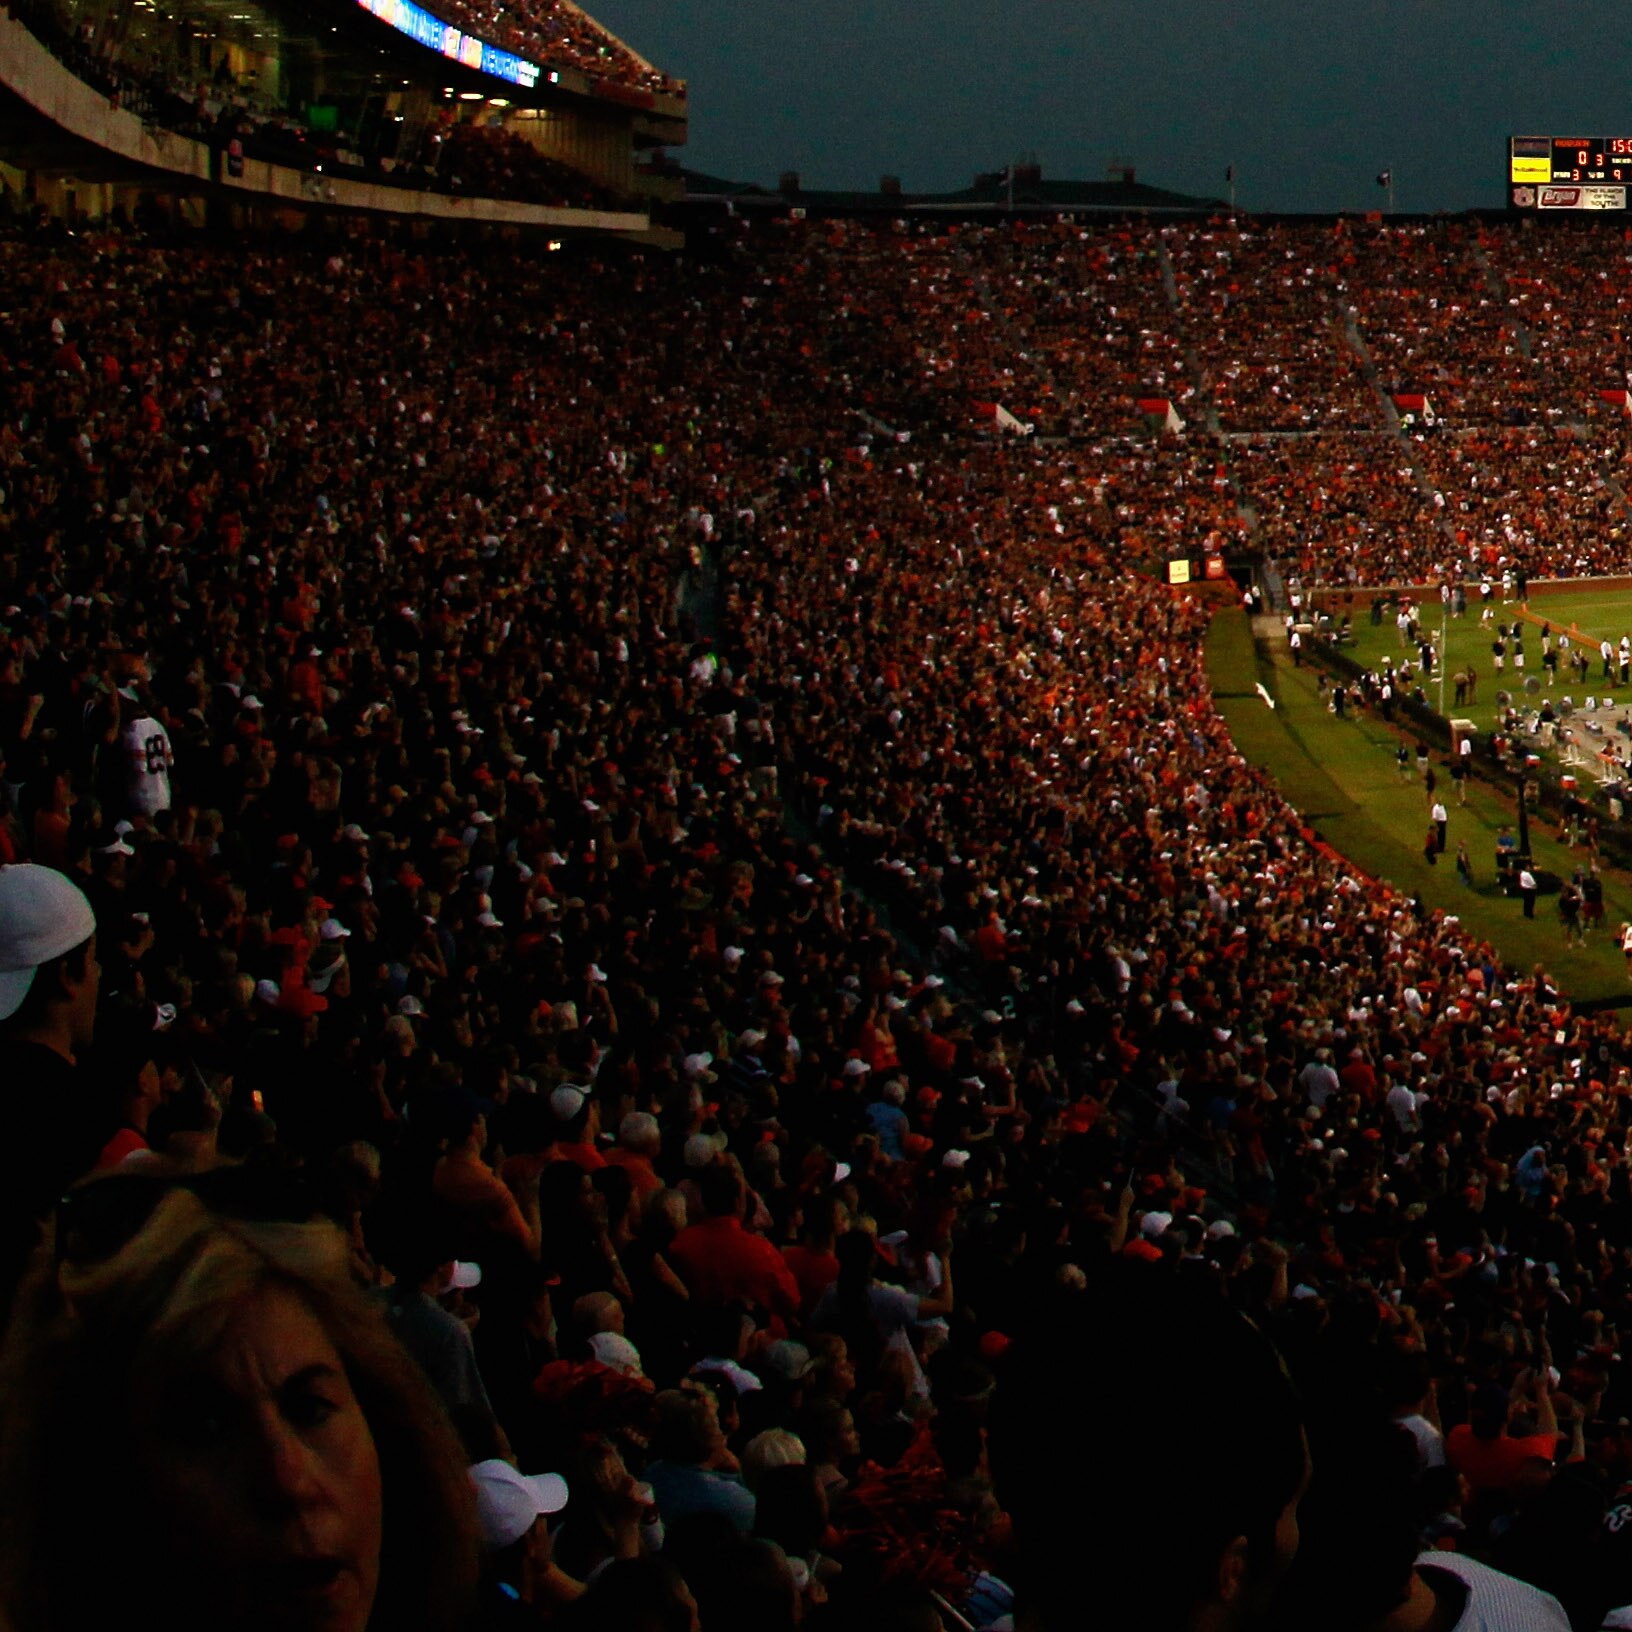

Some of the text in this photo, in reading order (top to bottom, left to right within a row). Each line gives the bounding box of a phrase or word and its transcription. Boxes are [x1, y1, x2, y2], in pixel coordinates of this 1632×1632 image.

[1578, 151, 1587, 165] 0
[1595, 154, 1603, 166] 3
[1571, 169, 1580, 181] 3
[1613, 169, 1621, 180] 9
[1545, 190, 1576, 204] Bryan
